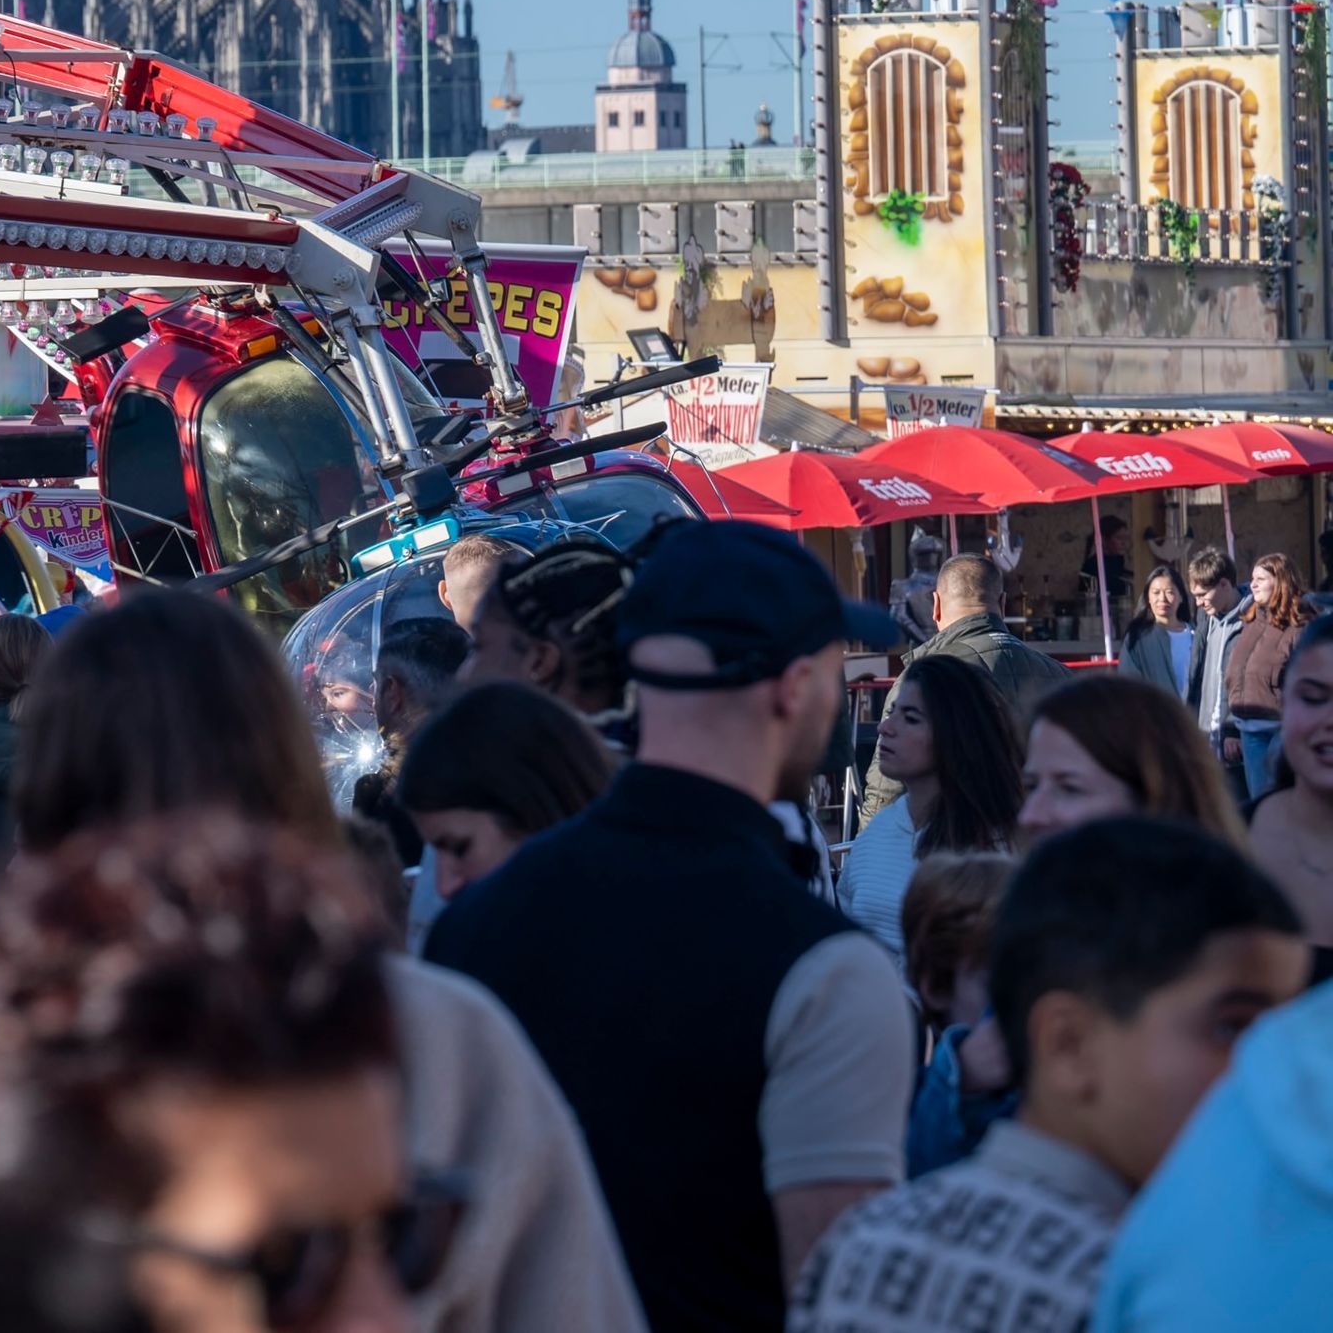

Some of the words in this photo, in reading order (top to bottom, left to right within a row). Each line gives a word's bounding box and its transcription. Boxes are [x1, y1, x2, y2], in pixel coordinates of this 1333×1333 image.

[689, 376, 715, 395] 1/2
[717, 376, 760, 395] Meter
[908, 393, 934, 416] 1/2
[936, 399, 976, 418] Meter
[667, 396, 761, 444] Rostbratwurst
[1094, 452, 1173, 475] Früh
[47, 528, 104, 548] kinder
